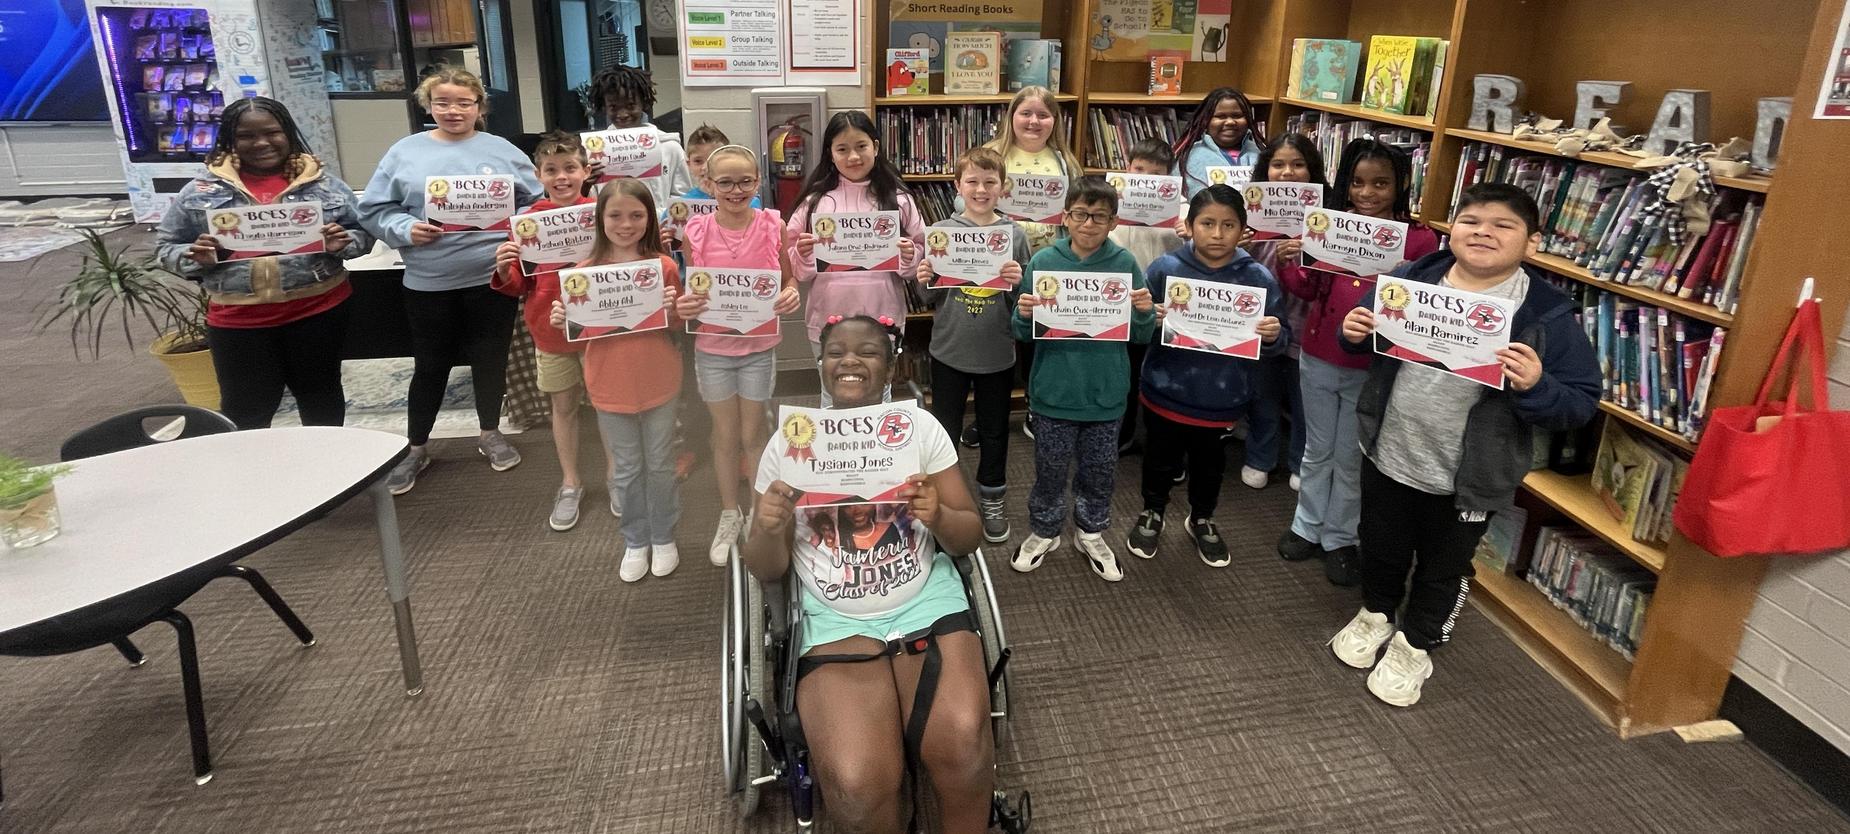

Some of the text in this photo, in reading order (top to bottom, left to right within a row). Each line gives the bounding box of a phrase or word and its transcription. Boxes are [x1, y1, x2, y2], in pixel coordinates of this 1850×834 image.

[755, 10, 775, 19] Talking
[908, 3, 1013, 15] Short Reading Books
[752, 36, 773, 44] Talking
[1373, 44, 1411, 60] Together
[757, 60, 778, 68] Talking
[606, 134, 635, 144] BCES
[453, 179, 486, 190] BCES
[1016, 177, 1044, 189] BCES
[1128, 178, 1157, 190] BCES
[1265, 186, 1298, 198] BCES
[243, 208, 288, 221] BCES
[540, 211, 576, 227] BCES
[1264, 208, 1278, 217] Mia
[838, 217, 872, 229] BCES
[1333, 216, 1372, 235] BCES
[951, 232, 986, 245] BCES
[1358, 246, 1386, 260] Dixon
[592, 268, 631, 284] BCES
[715, 273, 751, 288] BCES
[1062, 278, 1099, 292] BCES
[1195, 286, 1233, 303] BCES
[1414, 289, 1465, 314] BCES
[599, 297, 620, 309] Abby
[1404, 320, 1428, 334] Alan
[1430, 325, 1479, 346] Ramirez
[820, 415, 874, 437] BCES
[827, 440, 859, 453] RAIDER
[861, 439, 876, 451] KID
[808, 455, 893, 473] Tysiana Jones
[844, 552, 915, 588] JONES
[815, 579, 866, 600] Class
[869, 580, 888, 596] of
